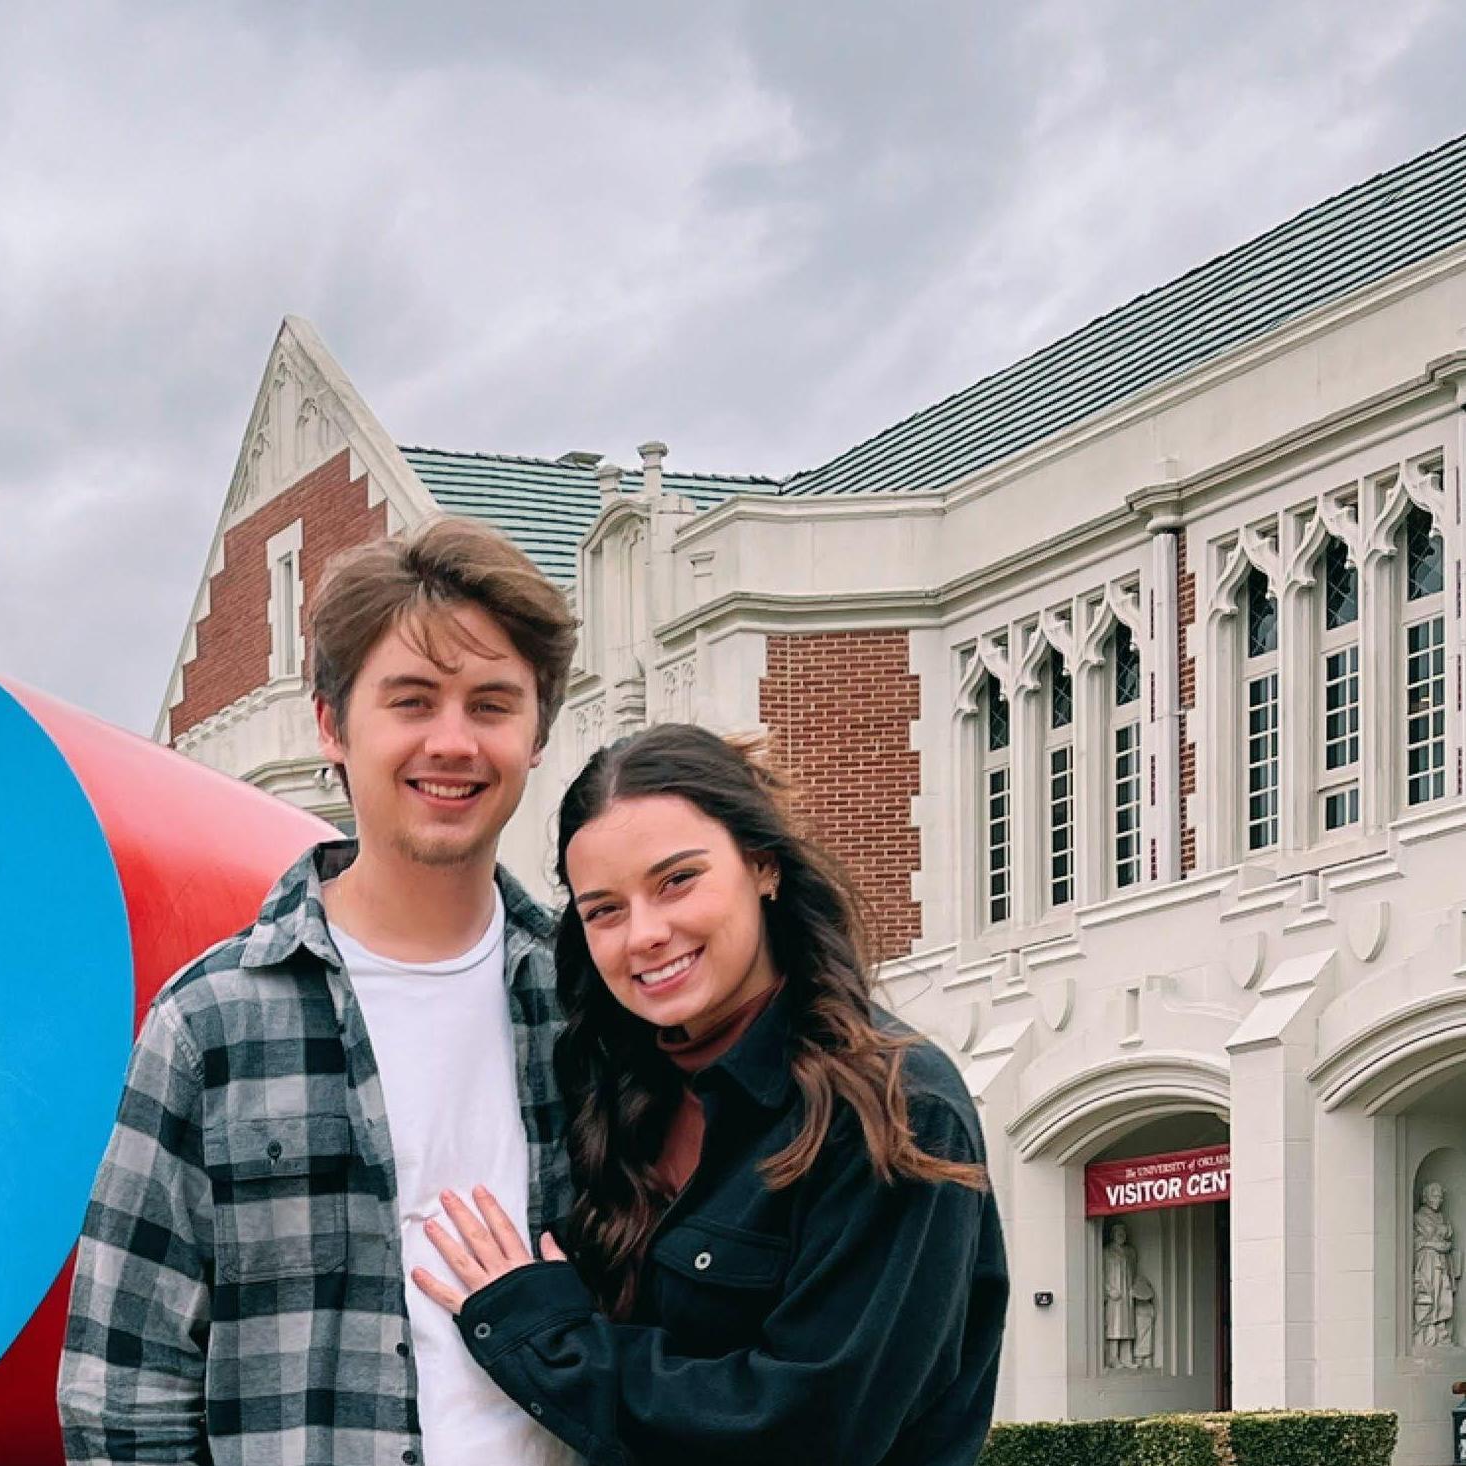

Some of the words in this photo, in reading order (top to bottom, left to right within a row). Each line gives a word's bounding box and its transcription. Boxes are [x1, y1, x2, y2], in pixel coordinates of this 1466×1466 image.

[1137, 1162, 1186, 1176] UNIVERSITY
[1188, 1158, 1196, 1172] of
[1106, 1178, 1181, 1206] VISITOR
